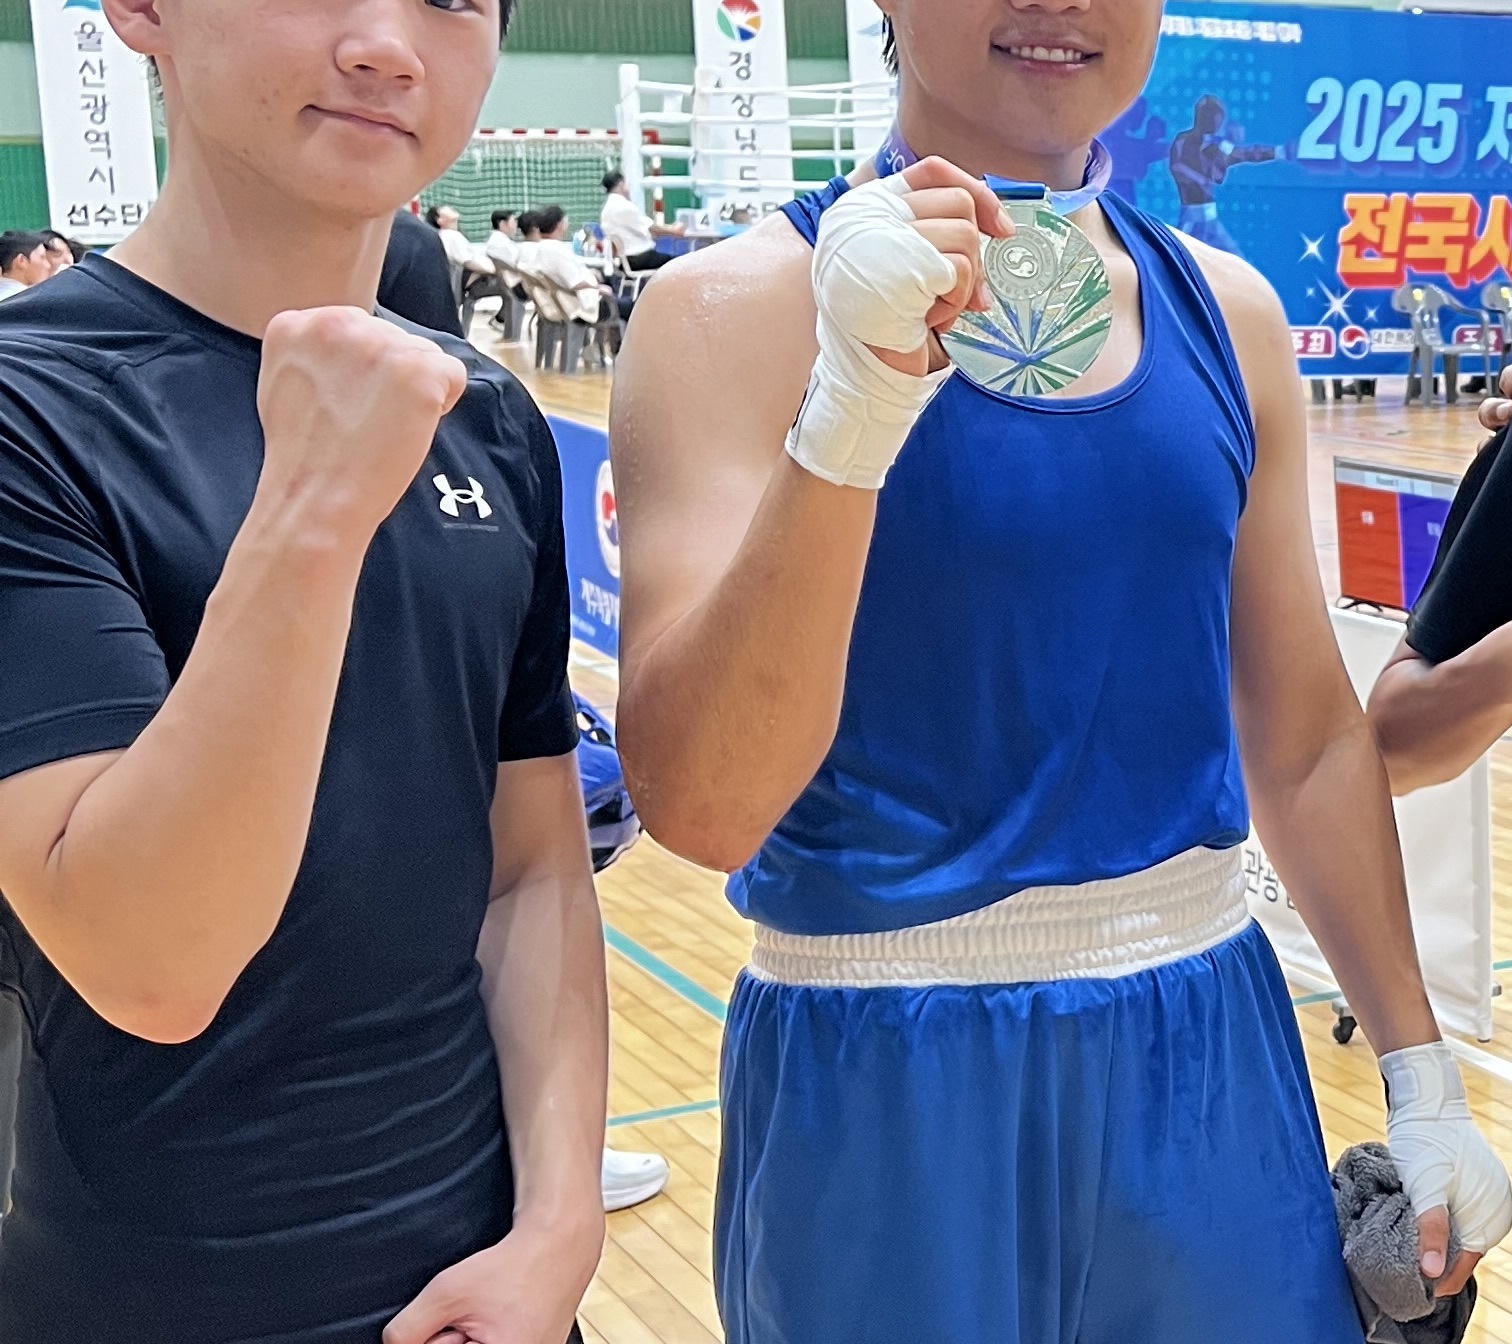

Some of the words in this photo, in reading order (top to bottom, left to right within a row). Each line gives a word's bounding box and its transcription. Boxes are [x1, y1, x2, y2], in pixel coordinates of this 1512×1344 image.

[72, 20, 116, 196] 울산광역시
[1298, 77, 1464, 164] 2025
[67, 203, 143, 228] 선수단
